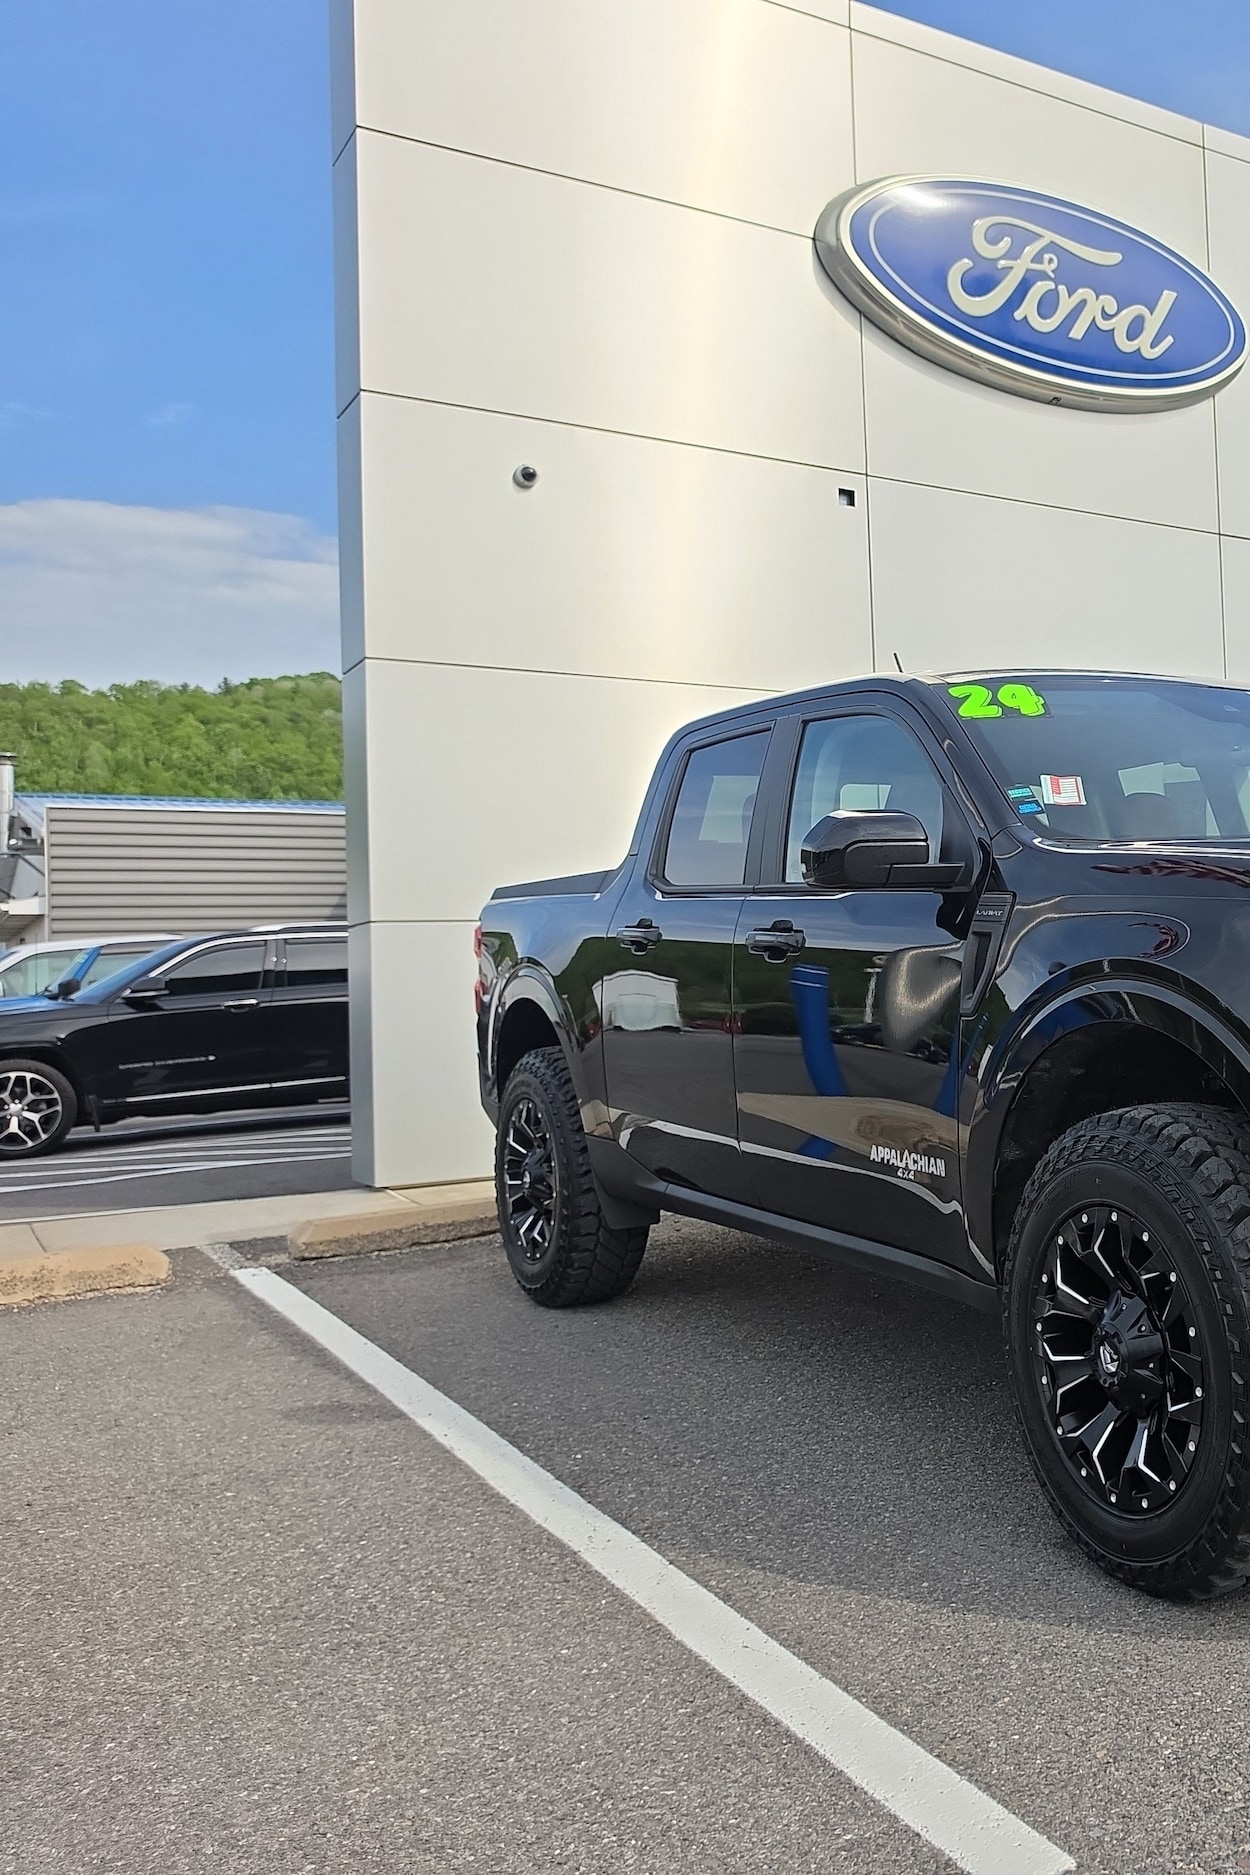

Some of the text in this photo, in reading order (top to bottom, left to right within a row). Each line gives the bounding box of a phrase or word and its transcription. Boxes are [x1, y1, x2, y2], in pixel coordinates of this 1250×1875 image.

[947, 215, 1178, 361] Ford
[948, 683, 1046, 719] 24
[869, 1144, 946, 1178] APPALACHIAN
